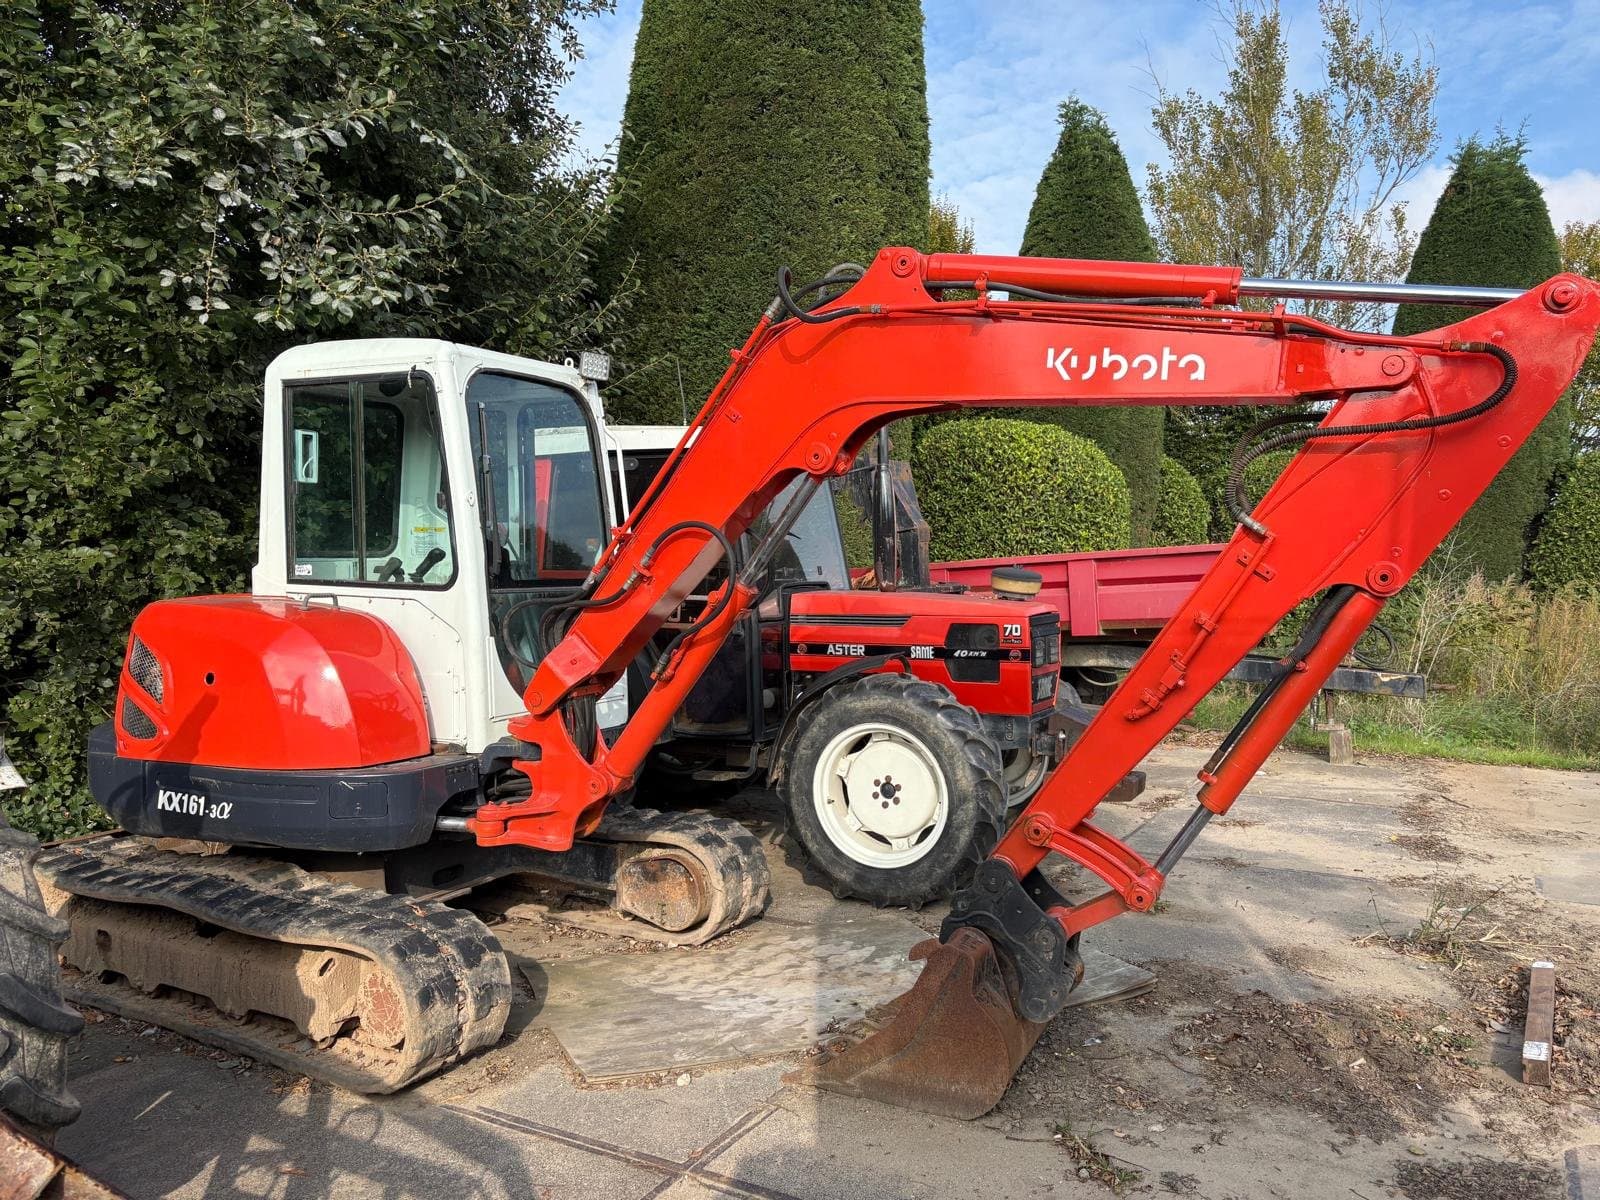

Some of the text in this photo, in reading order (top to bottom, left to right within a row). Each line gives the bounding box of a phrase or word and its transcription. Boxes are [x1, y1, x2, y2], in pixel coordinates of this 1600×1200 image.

[1046, 346, 1206, 381] Kubota
[1003, 624, 1021, 636] 70
[826, 644, 865, 656] ASTER
[910, 645, 935, 659] SAME
[953, 649, 968, 657] 40
